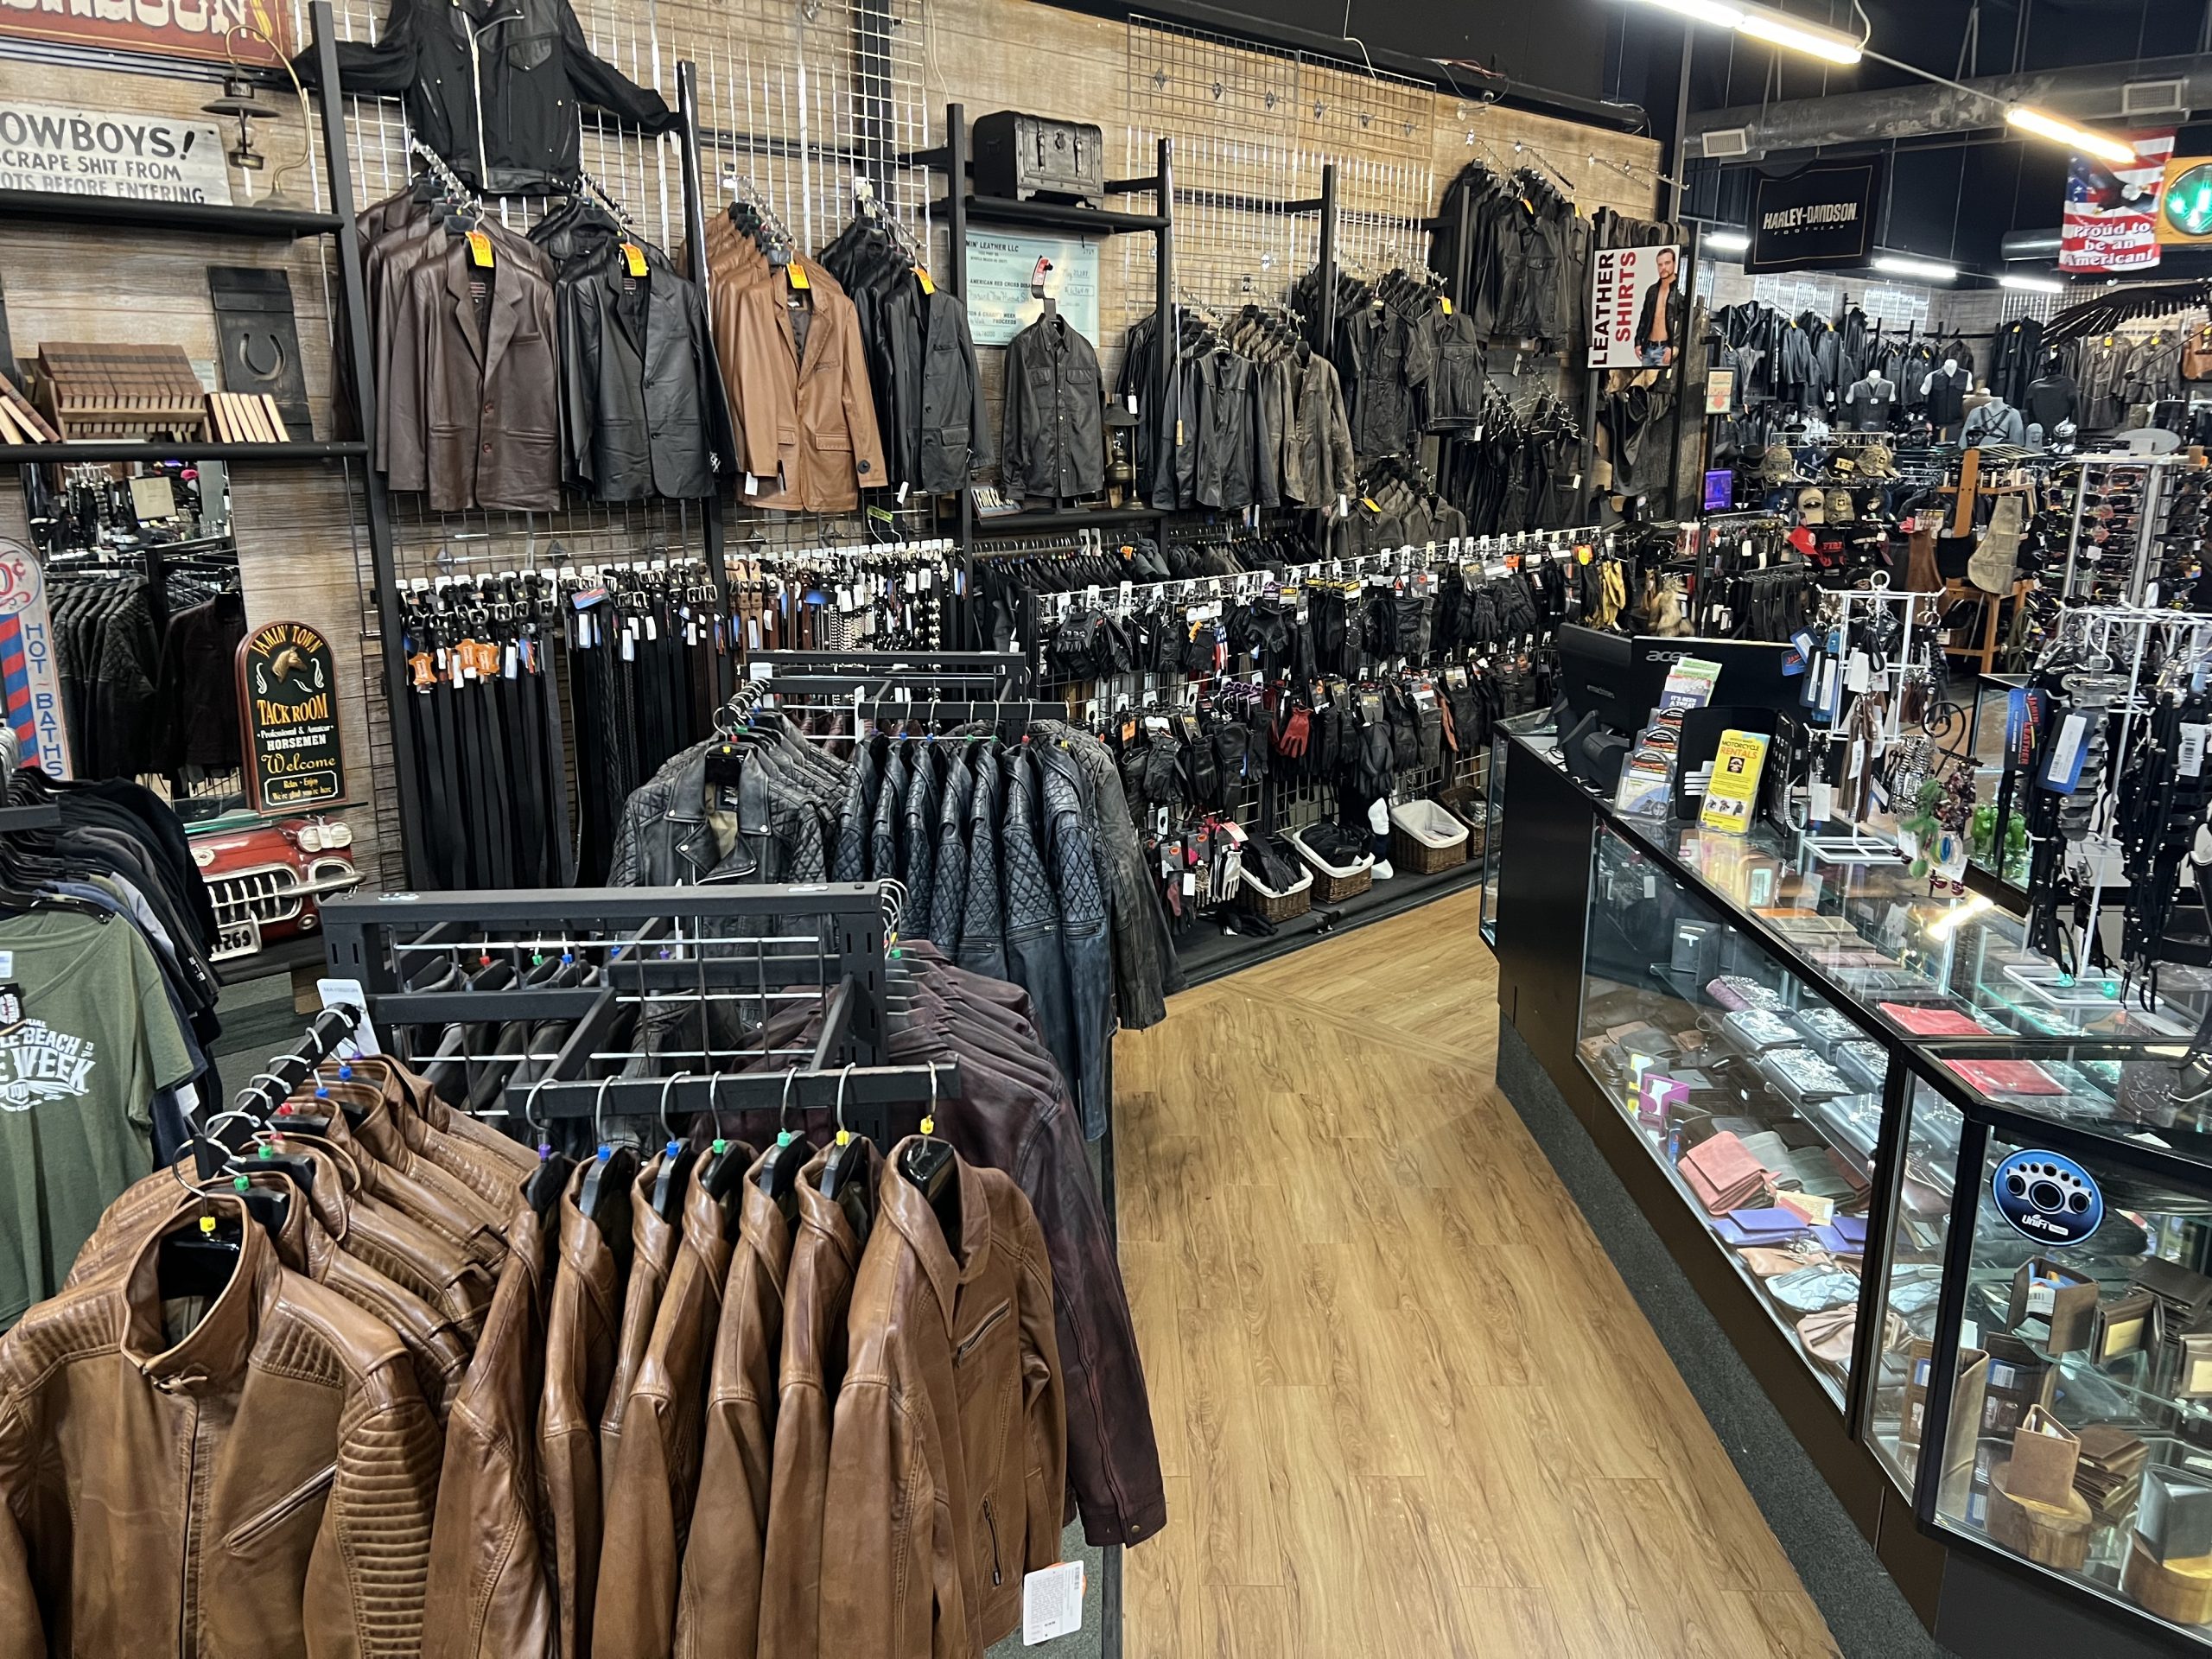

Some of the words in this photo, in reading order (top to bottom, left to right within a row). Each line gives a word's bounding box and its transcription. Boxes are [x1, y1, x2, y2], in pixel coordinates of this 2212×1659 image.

[0, 149, 71, 171] CRAPE
[78, 156, 118, 175] SHIT
[125, 161, 182, 181] FROM
[43, 174, 107, 195] BEFORE
[116, 181, 205, 204] ENTERING
[1763, 202, 1858, 230] HARLEY-DAVIDSON
[2074, 223, 2126, 238] Proud
[2131, 222, 2151, 233] to
[980, 242, 1007, 251] LEATHER
[1007, 244, 1019, 252] LLC
[2084, 240, 2106, 251] be
[2112, 238, 2135, 250] an
[1592, 252, 1614, 365] LEATHER
[1616, 251, 1637, 342] SHIRTS
[25, 623, 46, 674] HOT
[292, 626, 323, 653] TOWN
[257, 700, 291, 726] TACK
[291, 693, 328, 721] ROOM
[35, 693, 63, 777] BATHS
[261, 728, 296, 739] Professional
[267, 734, 327, 751] HORSEMEN
[1722, 741, 1759, 751] MOTORCYCLE
[2020, 721, 2032, 765] LEATHER
[261, 753, 336, 773] Welcome
[1720, 747, 1758, 759] RENTALS
[213, 931, 251, 952] 269
[22, 1027, 81, 1055] BEACH
[10, 1046, 96, 1092] WEEK
